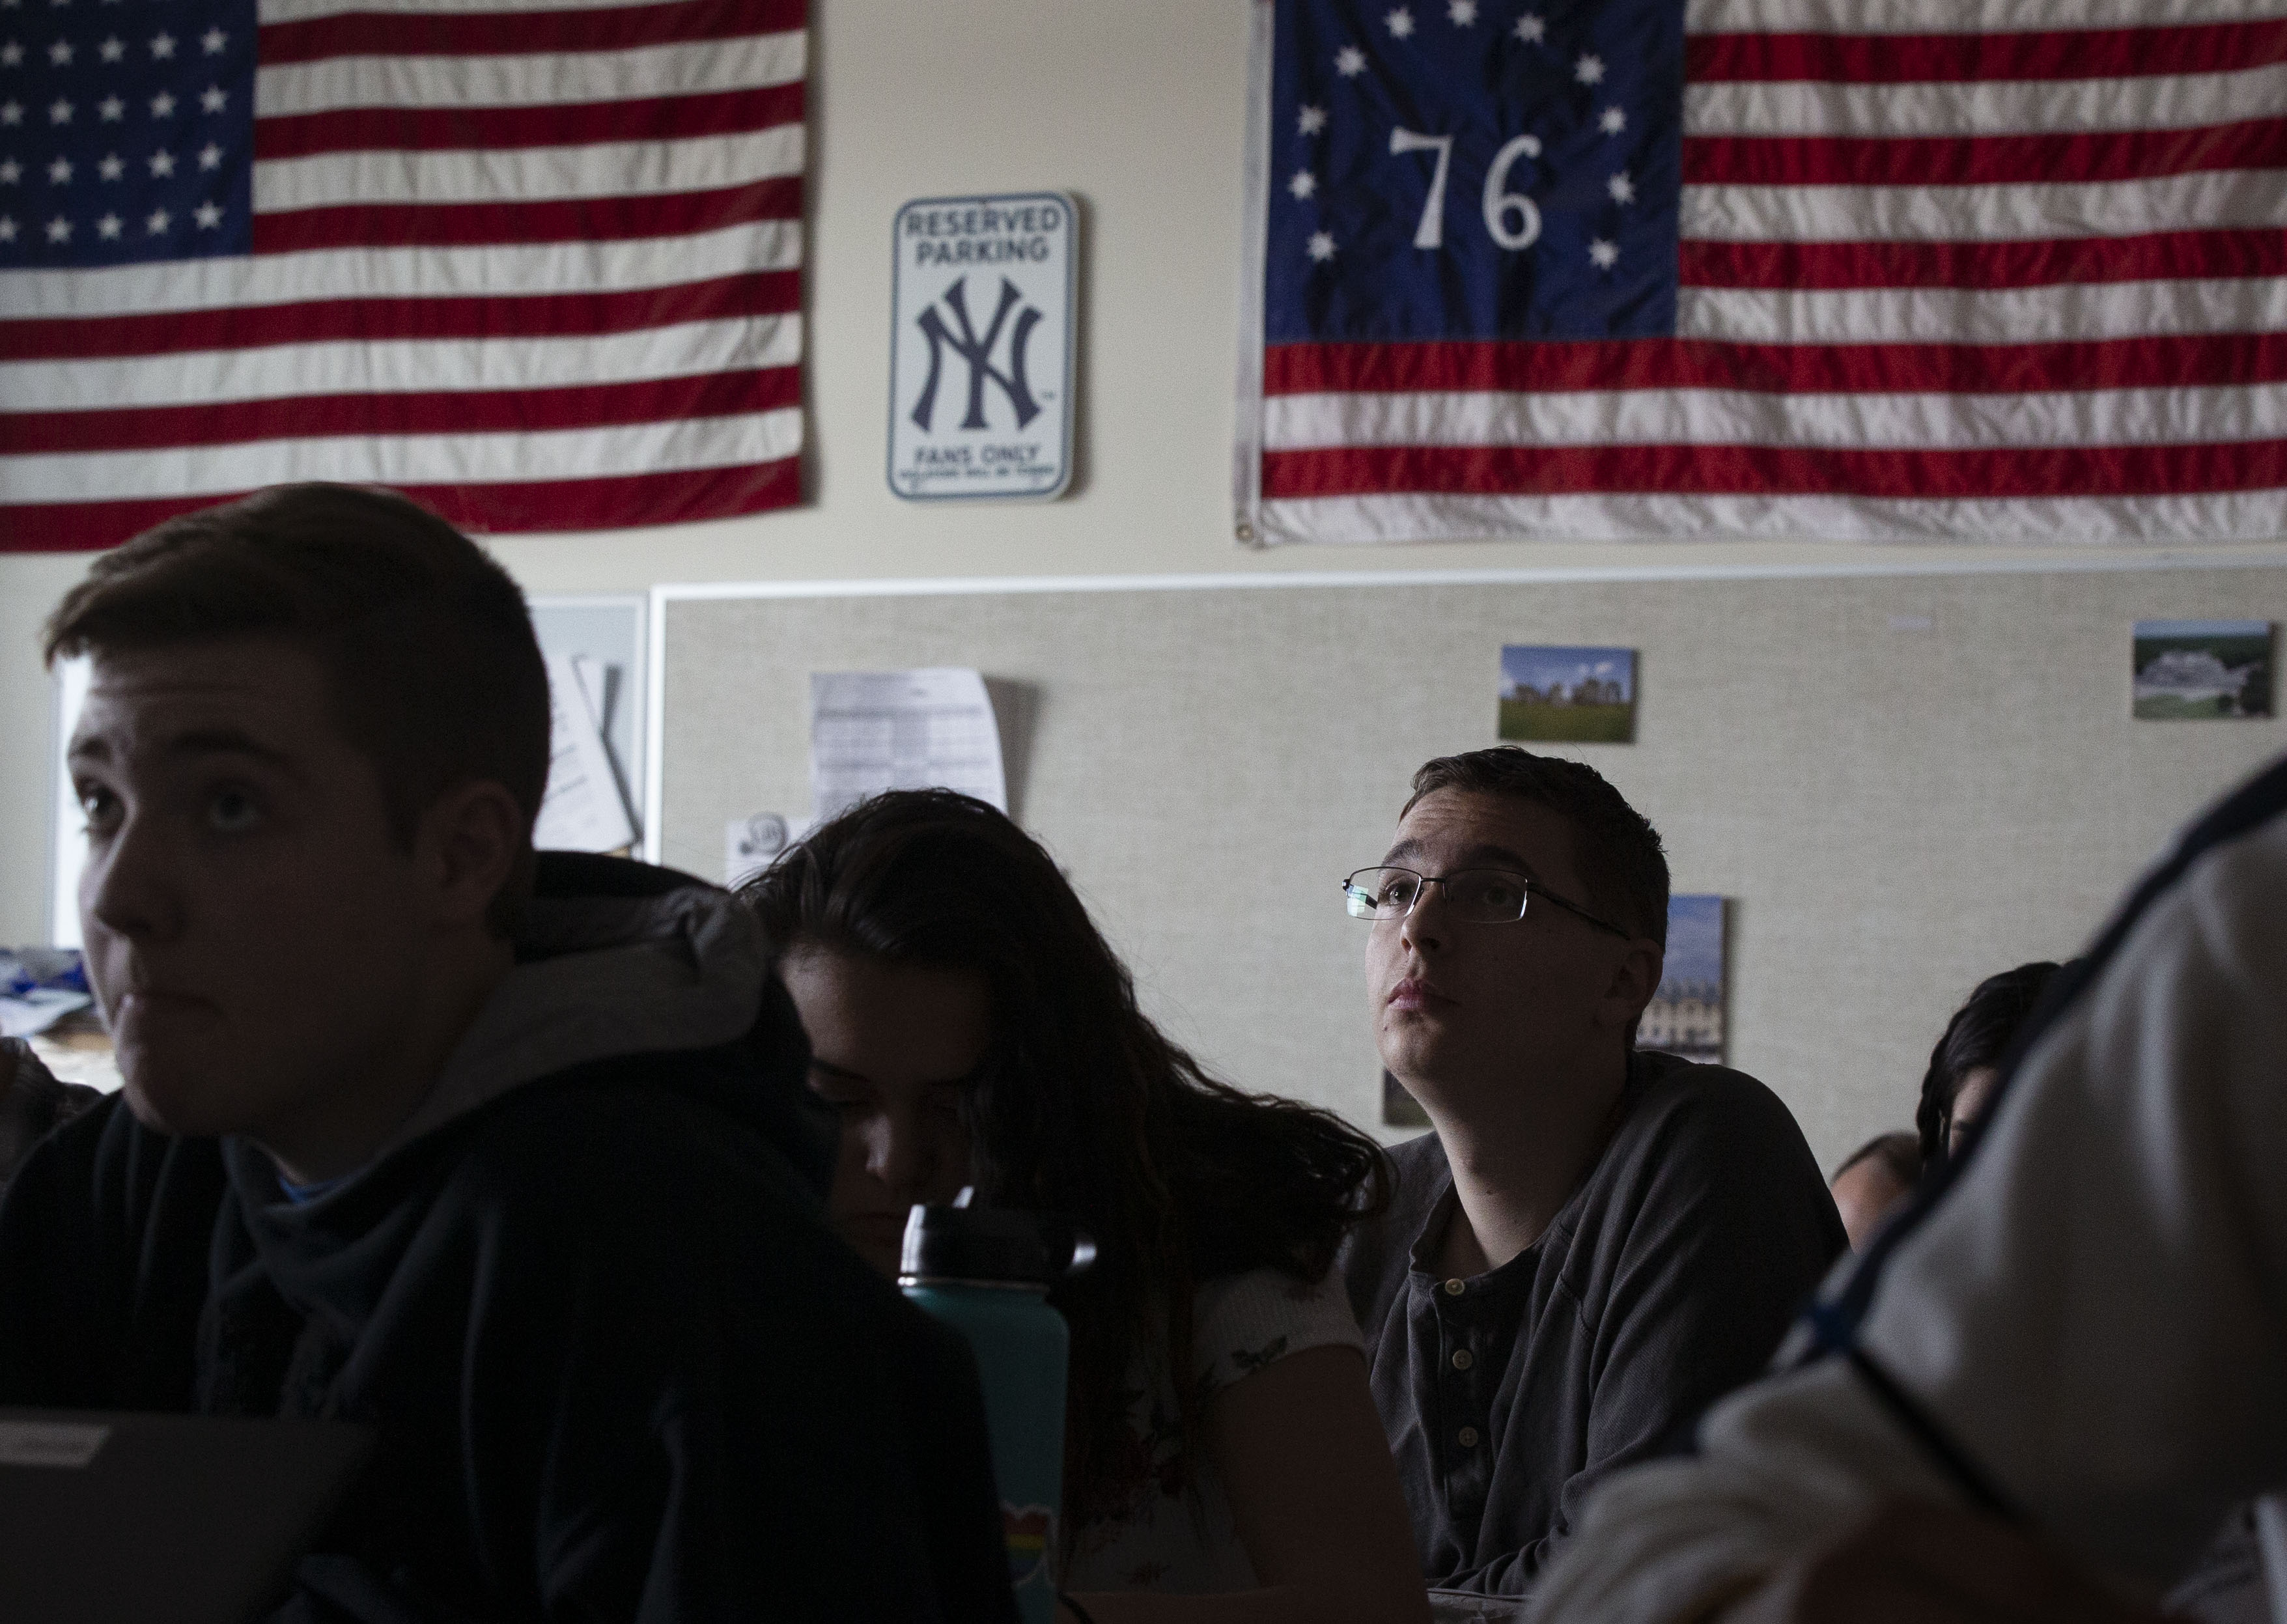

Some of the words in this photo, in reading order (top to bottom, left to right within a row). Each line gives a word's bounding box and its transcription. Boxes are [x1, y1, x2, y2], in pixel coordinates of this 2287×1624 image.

[1389, 126, 1542, 251] 76
[908, 206, 1060, 236] RESERVED
[916, 236, 1049, 264] PARKING
[914, 444, 972, 465] FANS
[981, 443, 1041, 464] ONLY
